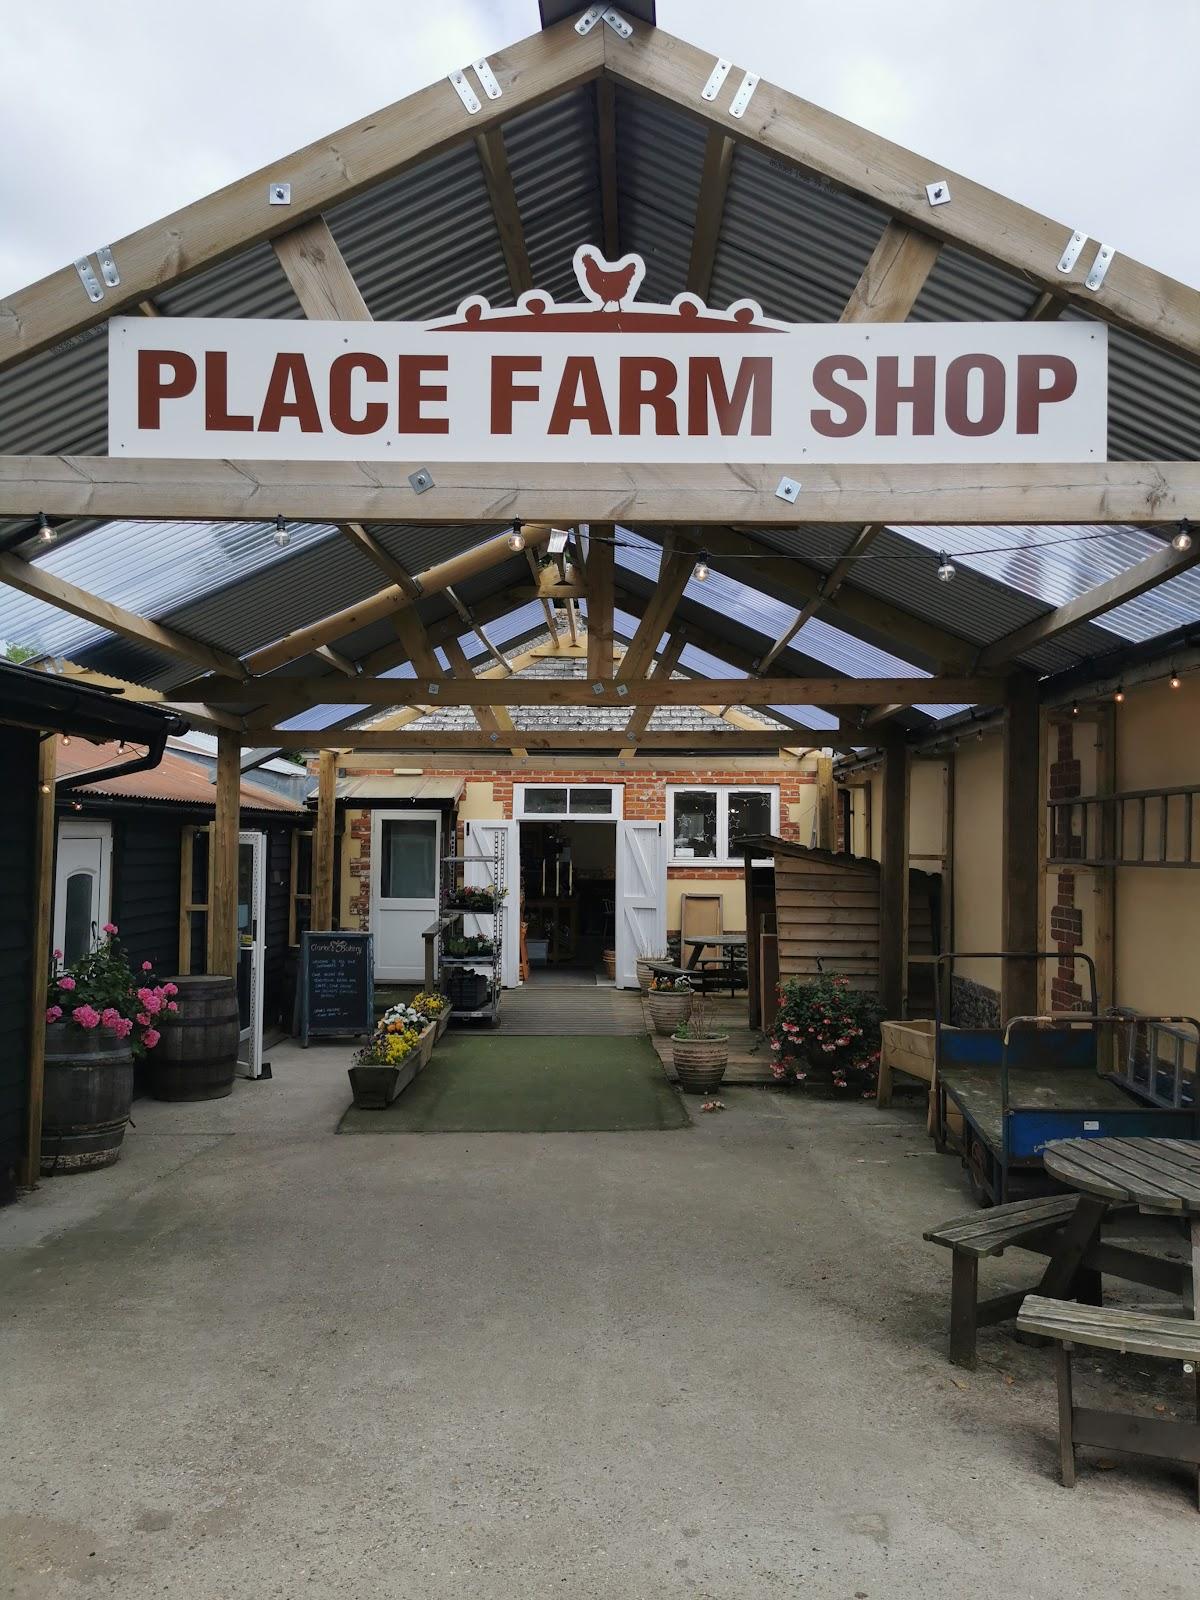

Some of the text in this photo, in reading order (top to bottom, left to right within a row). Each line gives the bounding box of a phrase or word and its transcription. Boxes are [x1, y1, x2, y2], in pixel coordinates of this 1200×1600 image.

[138, 350, 1077, 438] PLACE FARM SHOP
